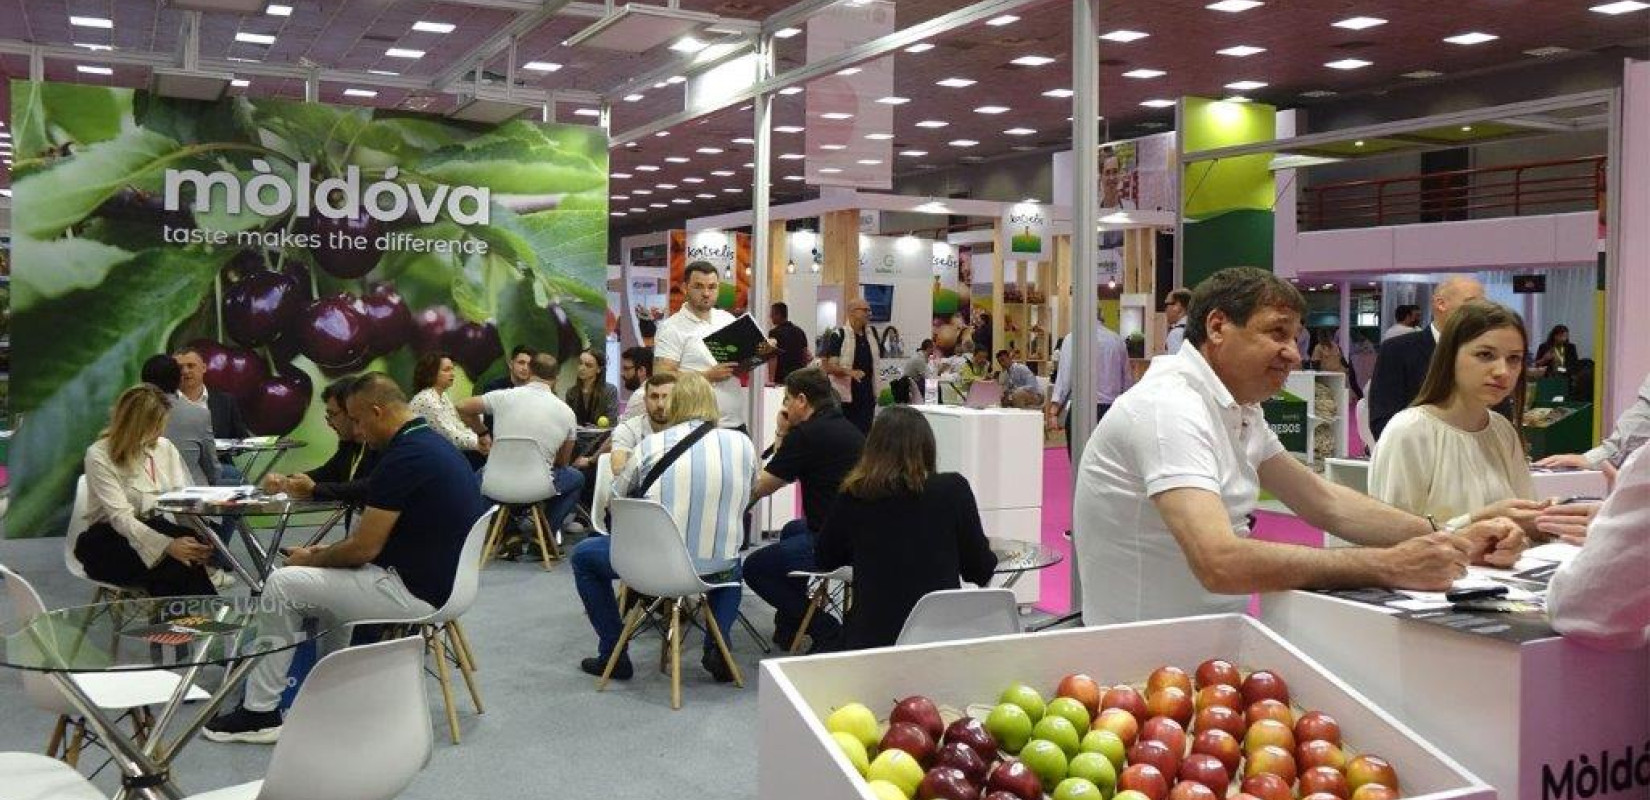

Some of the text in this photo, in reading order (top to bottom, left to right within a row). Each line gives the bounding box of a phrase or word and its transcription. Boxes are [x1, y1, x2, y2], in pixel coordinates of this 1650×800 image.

[163, 158, 490, 226] mòldóva
[163, 225, 489, 254] taste makes the difference
